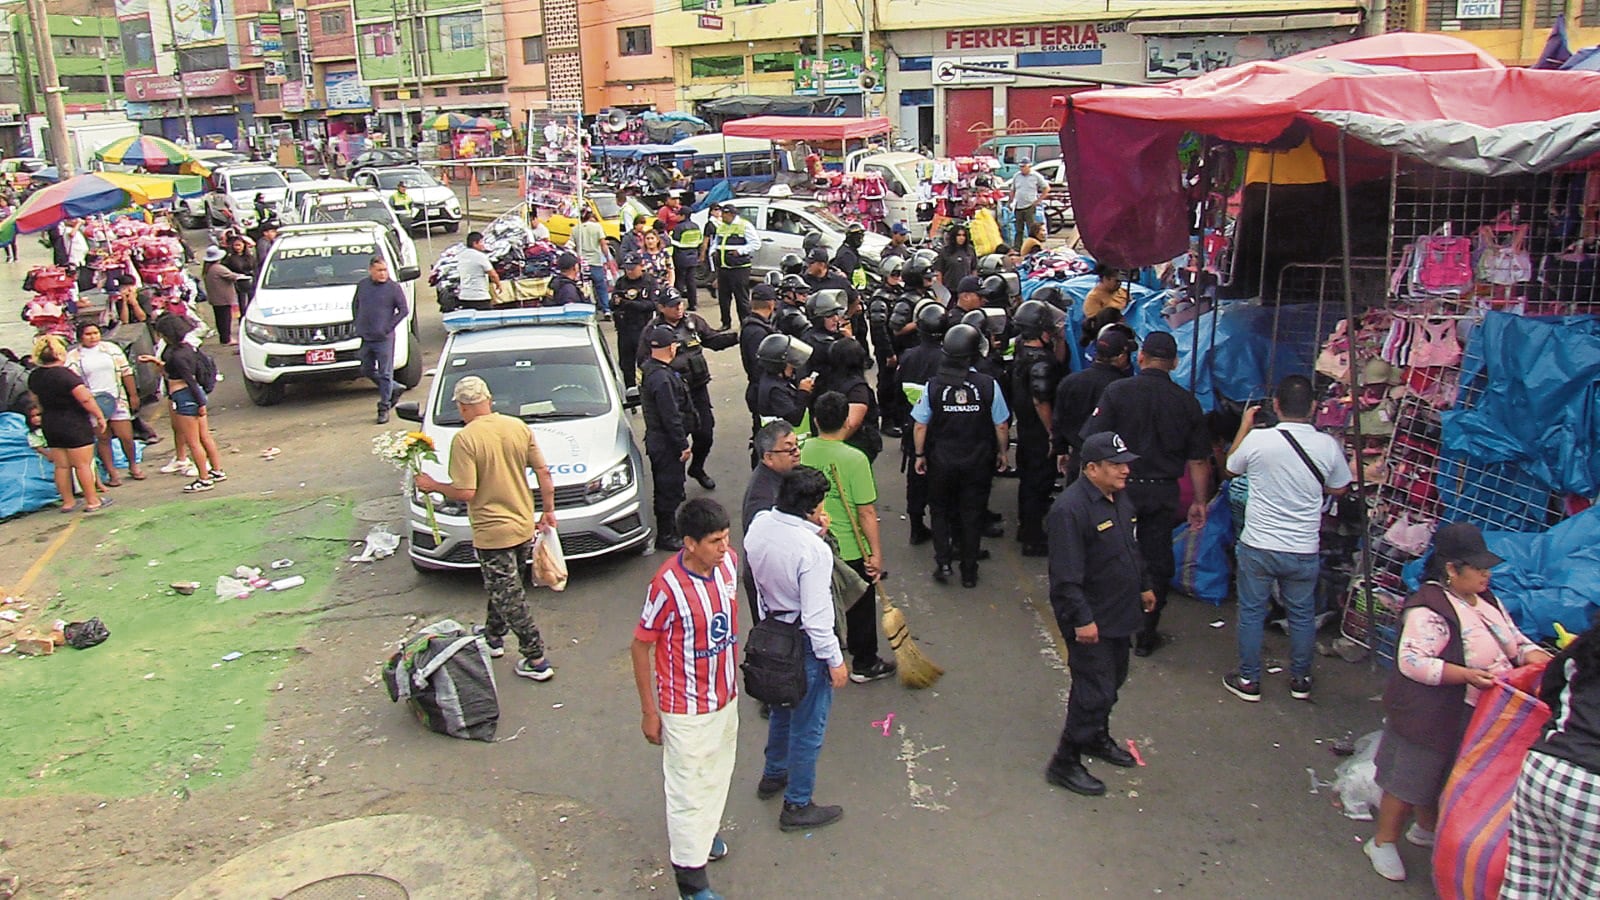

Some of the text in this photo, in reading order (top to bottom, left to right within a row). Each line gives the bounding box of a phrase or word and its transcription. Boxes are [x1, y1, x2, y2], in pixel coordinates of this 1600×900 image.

[946, 24, 1099, 50] FERRETERIA
[297, 10, 314, 89] DENTAL
[1041, 43, 1107, 52] COLCHONES
[280, 245, 375, 260] IRAM 104
